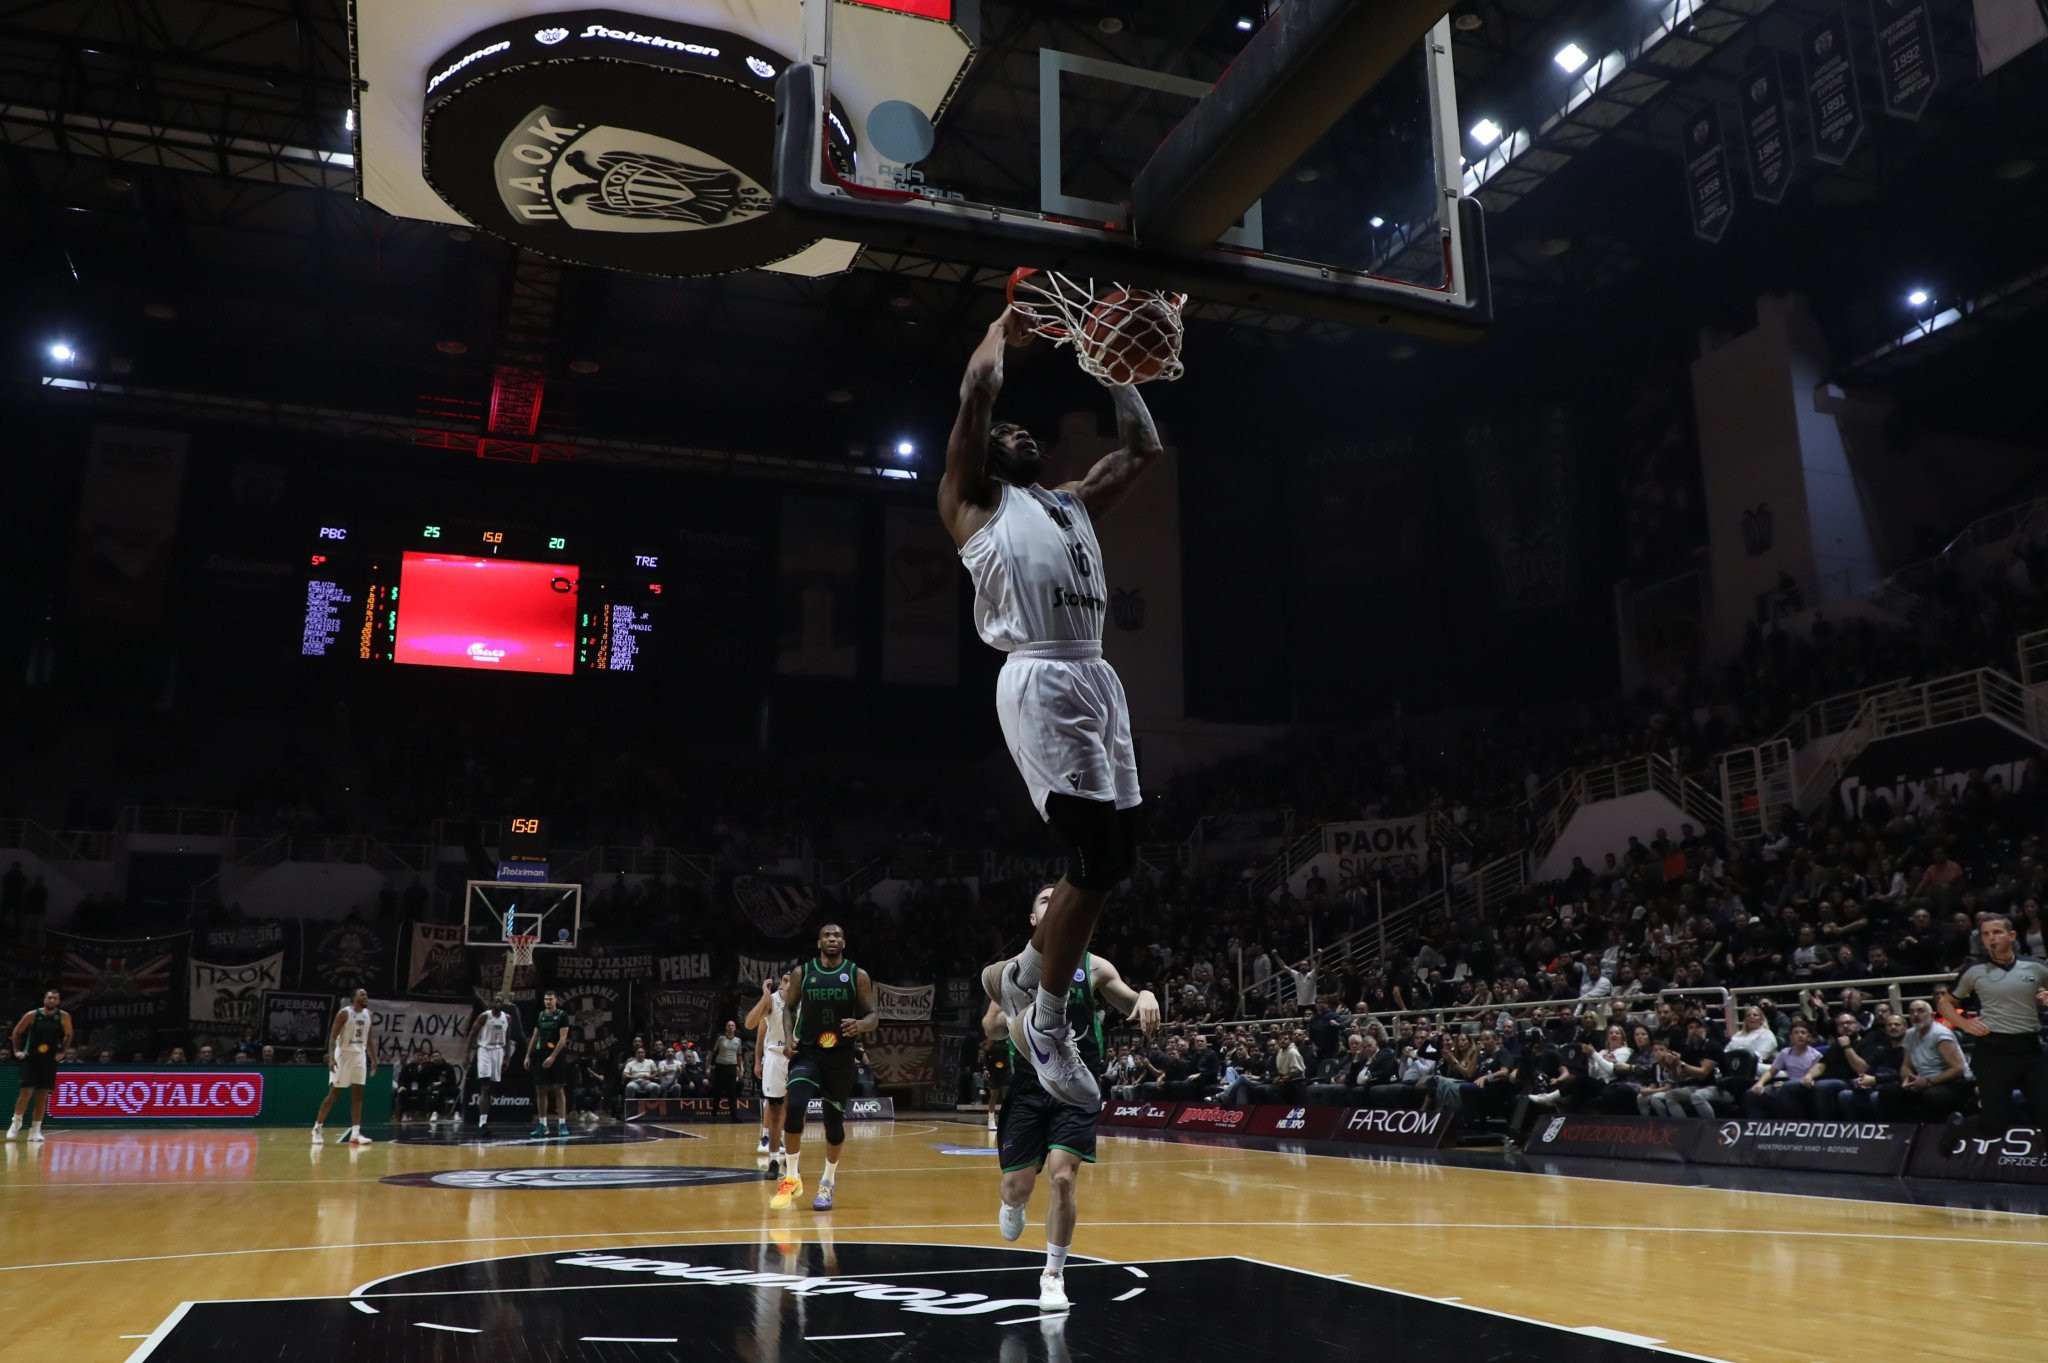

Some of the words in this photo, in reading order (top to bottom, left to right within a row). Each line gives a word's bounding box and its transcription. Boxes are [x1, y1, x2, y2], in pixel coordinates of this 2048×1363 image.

[580, 25, 721, 58] Stoiximan
[427, 39, 512, 95] Stoiximan
[1893, 45, 1921, 72] 1992
[1821, 94, 1847, 119] 1991
[320, 527, 347, 540] PBC
[424, 526, 440, 538] 25
[549, 537, 565, 549] 20
[635, 556, 659, 567] TRE
[1334, 825, 1418, 854] PAOK
[500, 866, 545, 877] Stoiximan
[659, 953, 710, 982] PEREA
[806, 988, 849, 1001] TREPCA
[57, 1080, 256, 1115] BOROTALCO
[1347, 1108, 1441, 1135] FARCOM
[1743, 1121, 1890, 1141] ΣΙΔΗΡΟΠΟΥΛΟΣ
[1998, 1156, 2037, 1167] OFFICE
